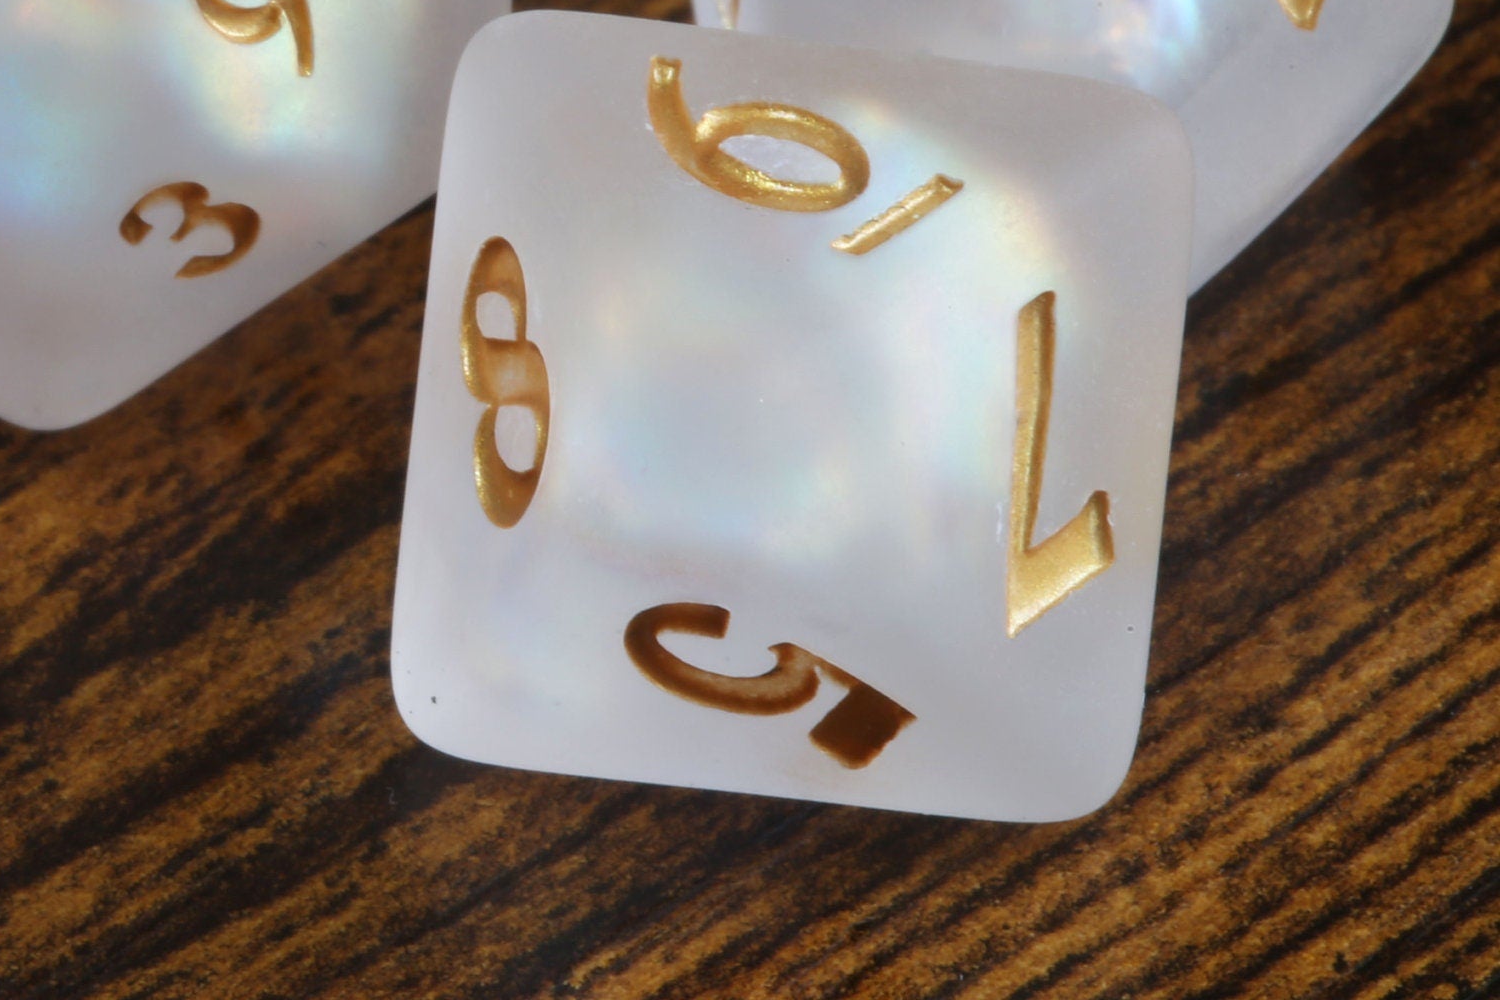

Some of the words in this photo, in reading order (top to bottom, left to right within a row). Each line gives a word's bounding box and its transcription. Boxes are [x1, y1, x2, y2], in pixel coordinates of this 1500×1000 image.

[118, 180, 264, 281] 3
[458, 235, 552, 530] 8
[1005, 290, 1118, 639] 7
[623, 602, 918, 771] 5
